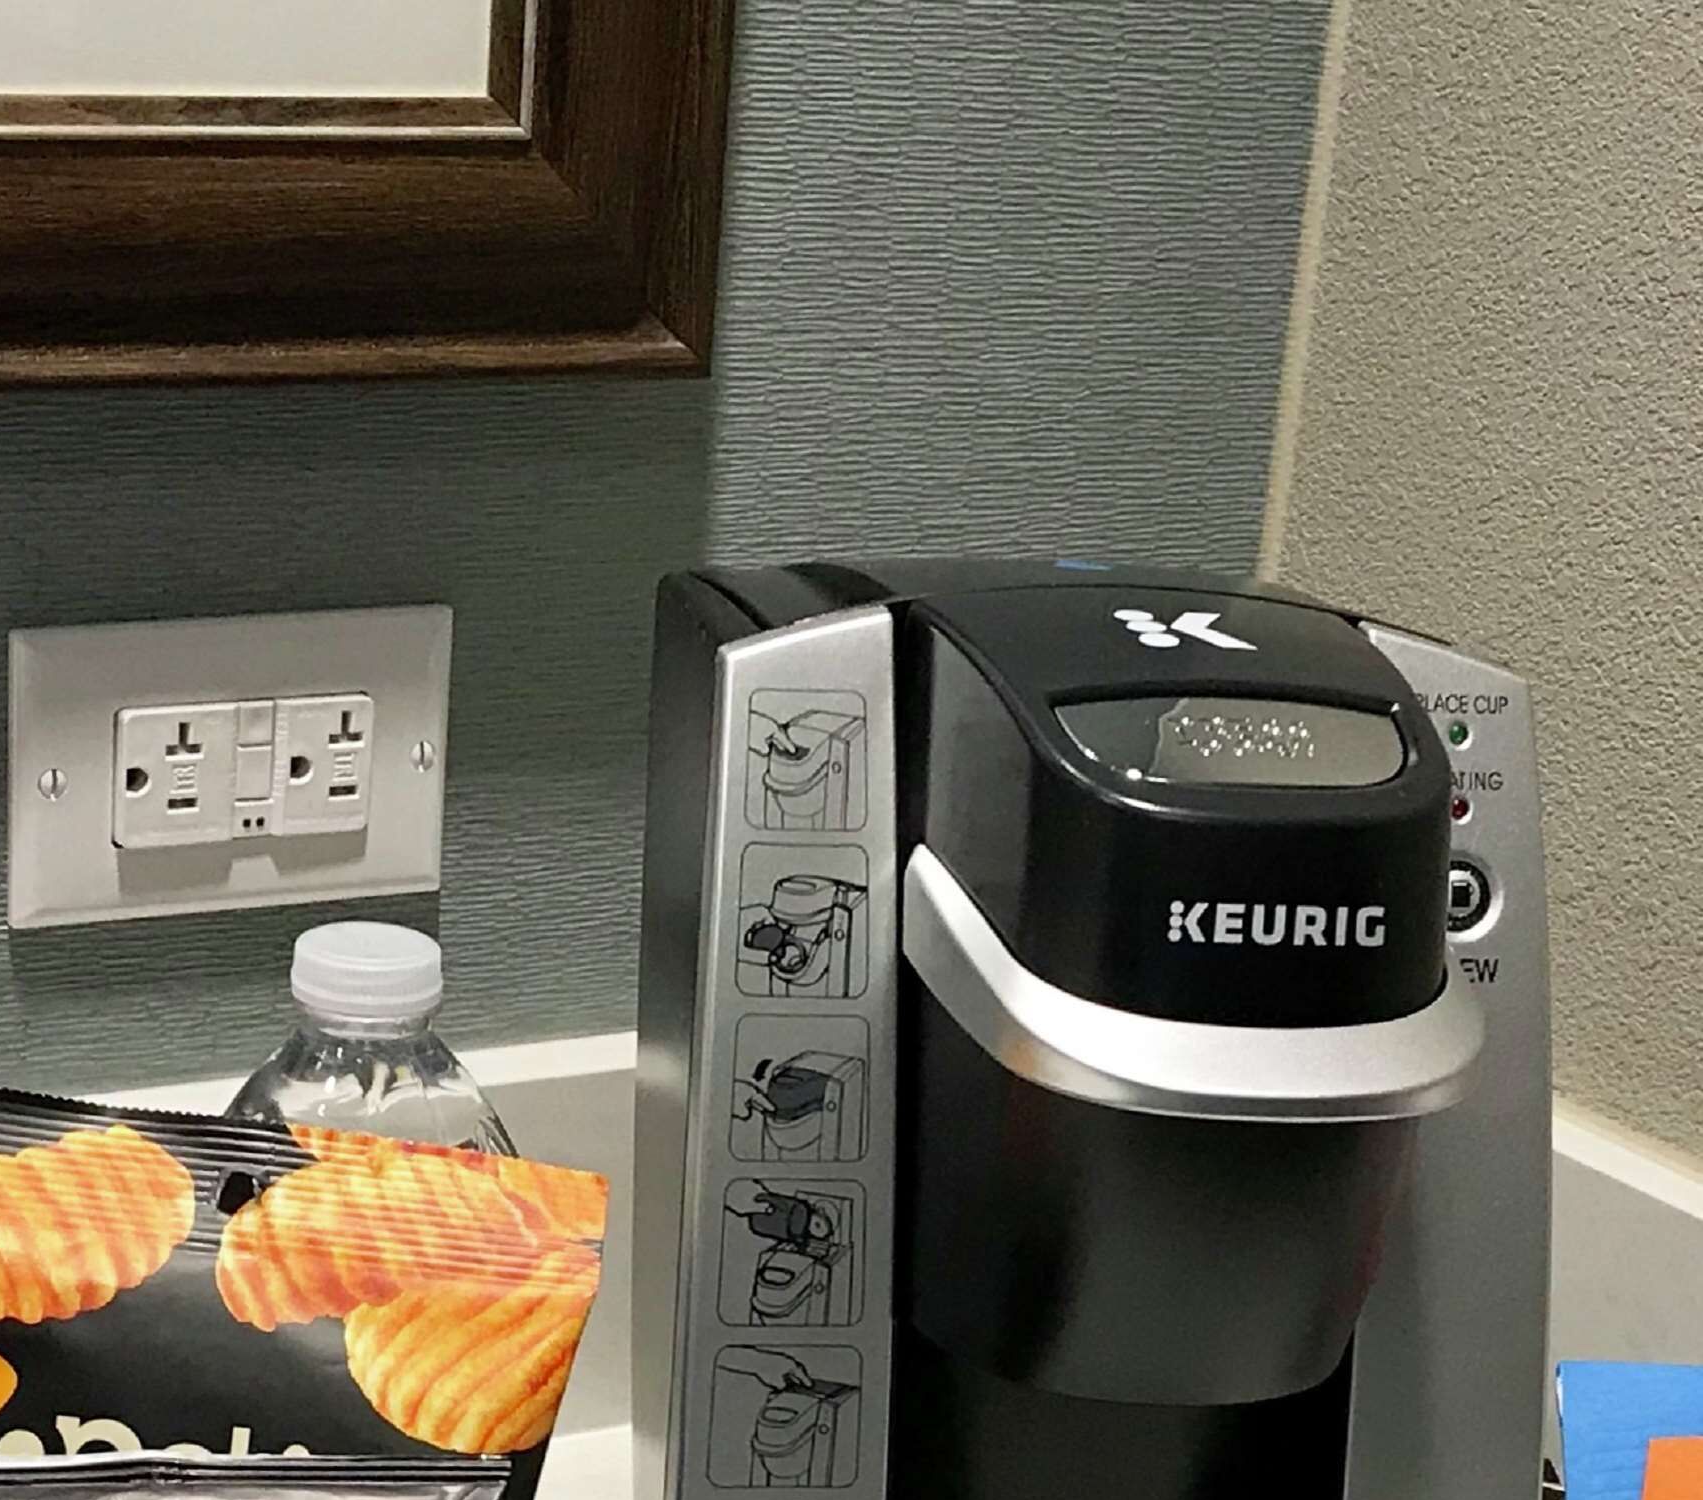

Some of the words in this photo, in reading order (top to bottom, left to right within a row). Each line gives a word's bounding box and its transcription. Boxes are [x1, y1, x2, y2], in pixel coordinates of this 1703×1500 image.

[1473, 694, 1509, 715] CUP
[1449, 771, 1503, 791] ATING
[1167, 900, 1386, 947] KEURIG
[1459, 958, 1499, 983] EW
